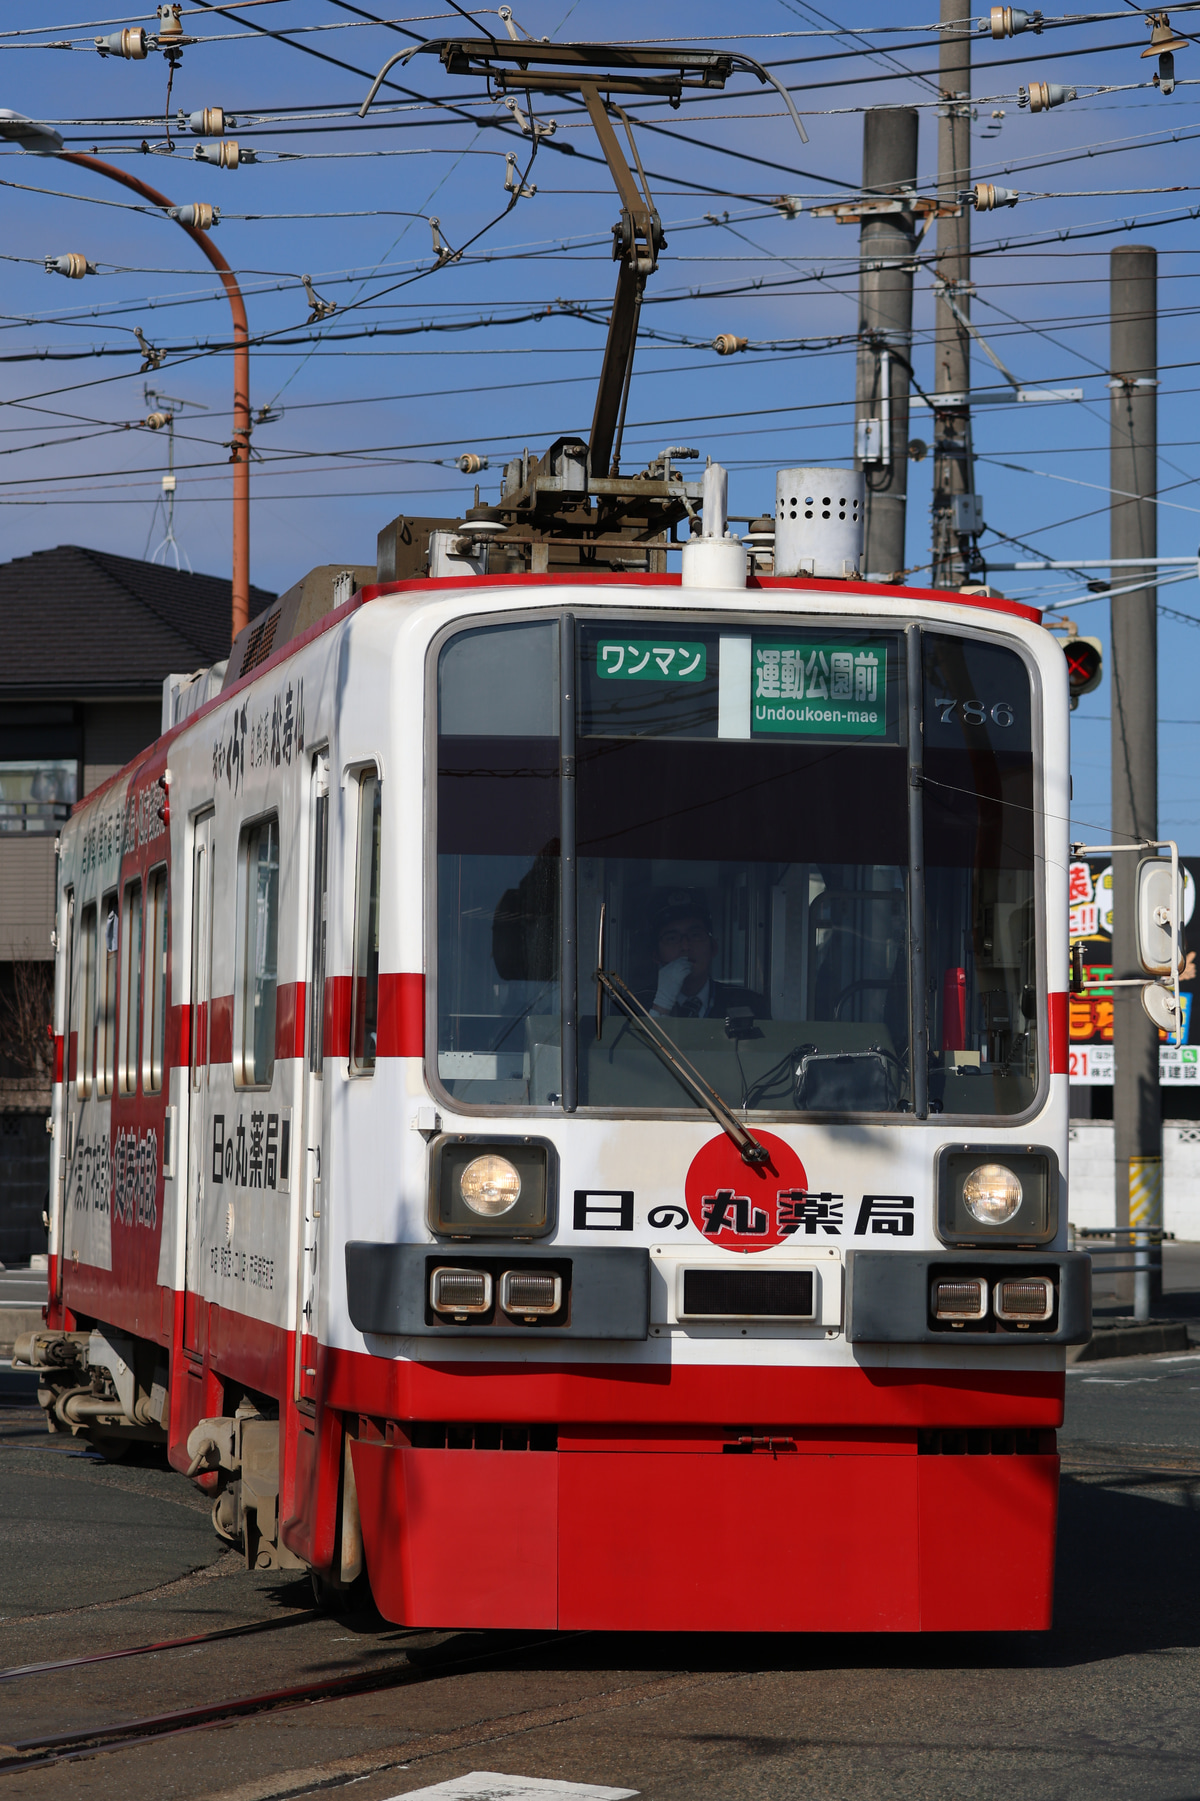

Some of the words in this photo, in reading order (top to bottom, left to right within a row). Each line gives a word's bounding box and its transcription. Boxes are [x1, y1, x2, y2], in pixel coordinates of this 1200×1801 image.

[602, 645, 701, 675] ワンマン
[755, 649, 879, 702] 運動公園前
[755, 704, 878, 724] Undoukoen-mae
[934, 697, 1015, 728] 786
[212, 1110, 279, 1190] 日の丸薬局
[573, 1188, 915, 1236] 日の丸薬局
